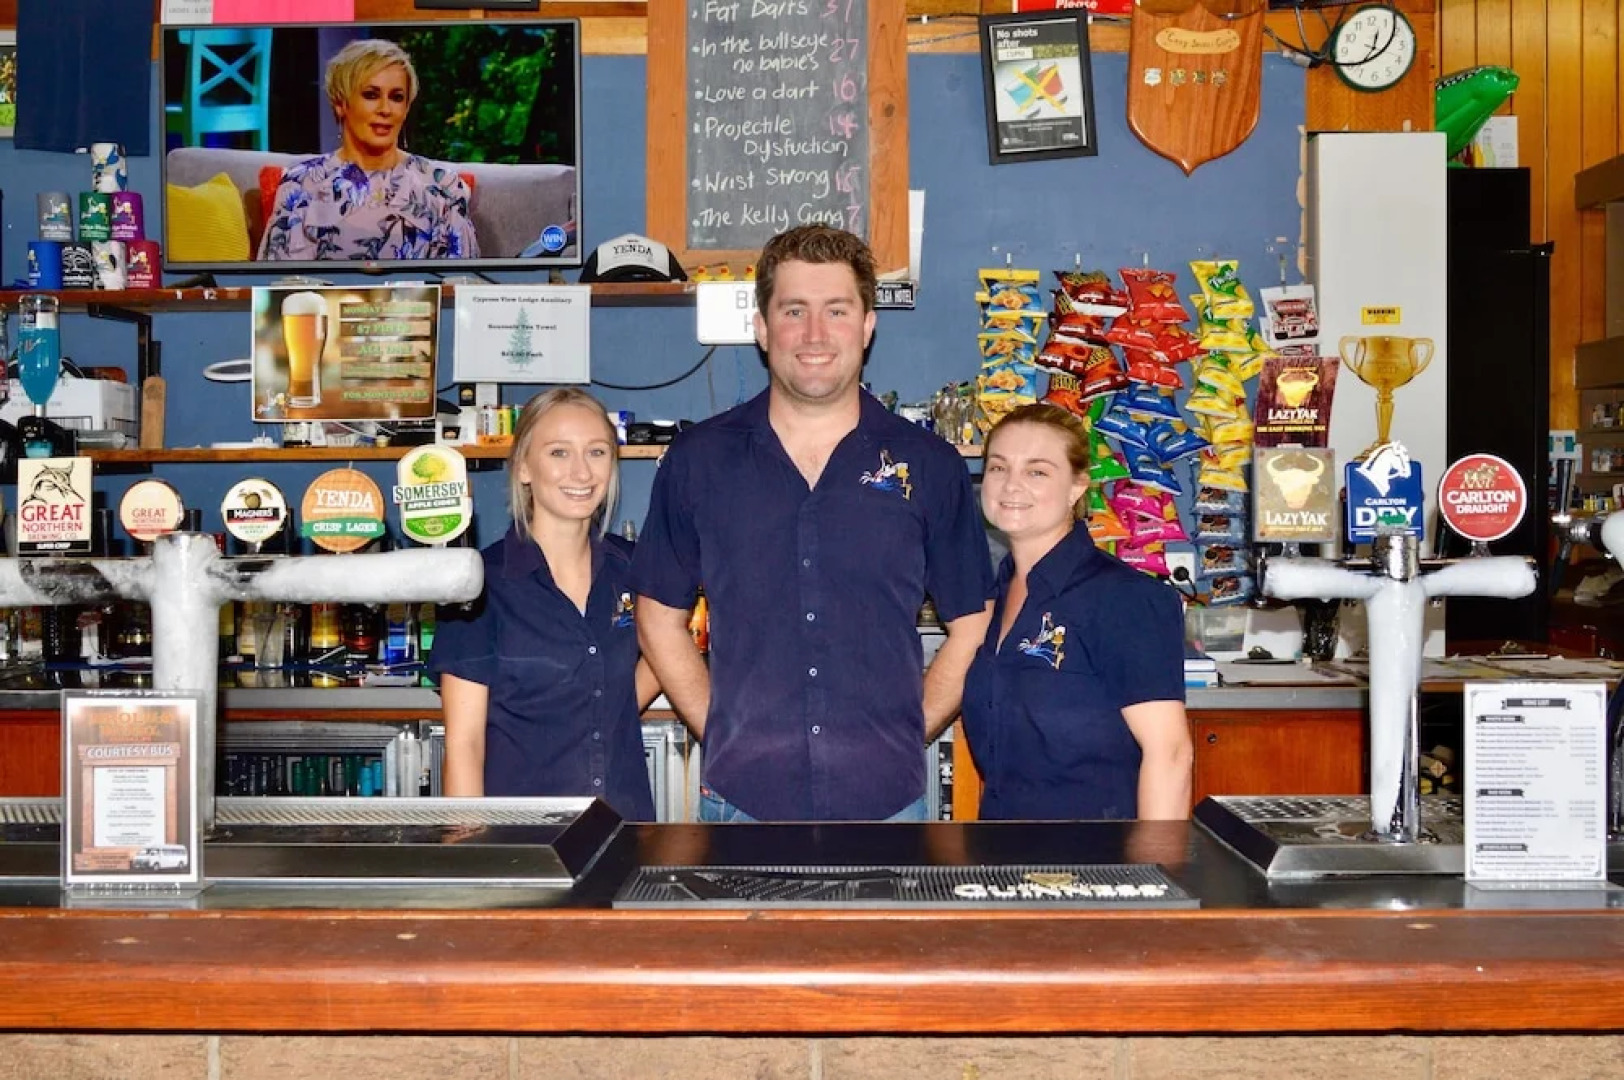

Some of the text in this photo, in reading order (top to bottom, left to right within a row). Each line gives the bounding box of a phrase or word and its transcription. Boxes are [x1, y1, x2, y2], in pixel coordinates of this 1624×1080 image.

[705, 1, 739, 23] Fat
[752, 0, 808, 19] Darts
[1366, 15, 1376, 26] 12
[996, 27, 1039, 40] No shots
[1345, 33, 1357, 43] 10
[702, 31, 860, 63] In the bullseye 27
[996, 39, 1020, 48] after
[1398, 40, 1406, 51] 3
[1341, 46, 1349, 57] 9
[733, 55, 819, 73] no babies
[1370, 71, 1380, 82] 6
[1384, 66, 1393, 77] 5
[705, 85, 746, 103] Love
[752, 87, 766, 100] a
[772, 80, 820, 100] dart
[705, 114, 792, 141] Projectile
[706, 170, 755, 193] Wrist
[766, 168, 830, 199] Strong
[700, 208, 733, 228] The
[797, 202, 845, 231] Gang
[846, 205, 861, 234] 7
[543, 233, 563, 243] WIN
[613, 244, 653, 259] YENDA
[518, 296, 539, 305] Lodge
[395, 481, 465, 501] SOMERSBY
[1446, 490, 1516, 504] CARLTON
[314, 488, 375, 512] YENDA
[407, 501, 428, 509] APPLE
[1364, 497, 1406, 506] CARLTON
[21, 504, 84, 522] GREAT
[131, 507, 167, 519] GREAT
[234, 508, 273, 518] MAGNERS
[1456, 504, 1509, 514] DRAUGHT
[22, 522, 83, 533] NORTHERN
[313, 522, 377, 532] CRISP LAGER
[87, 744, 173, 759] COURTESY BUS
[954, 882, 1168, 899] GUINNESS
